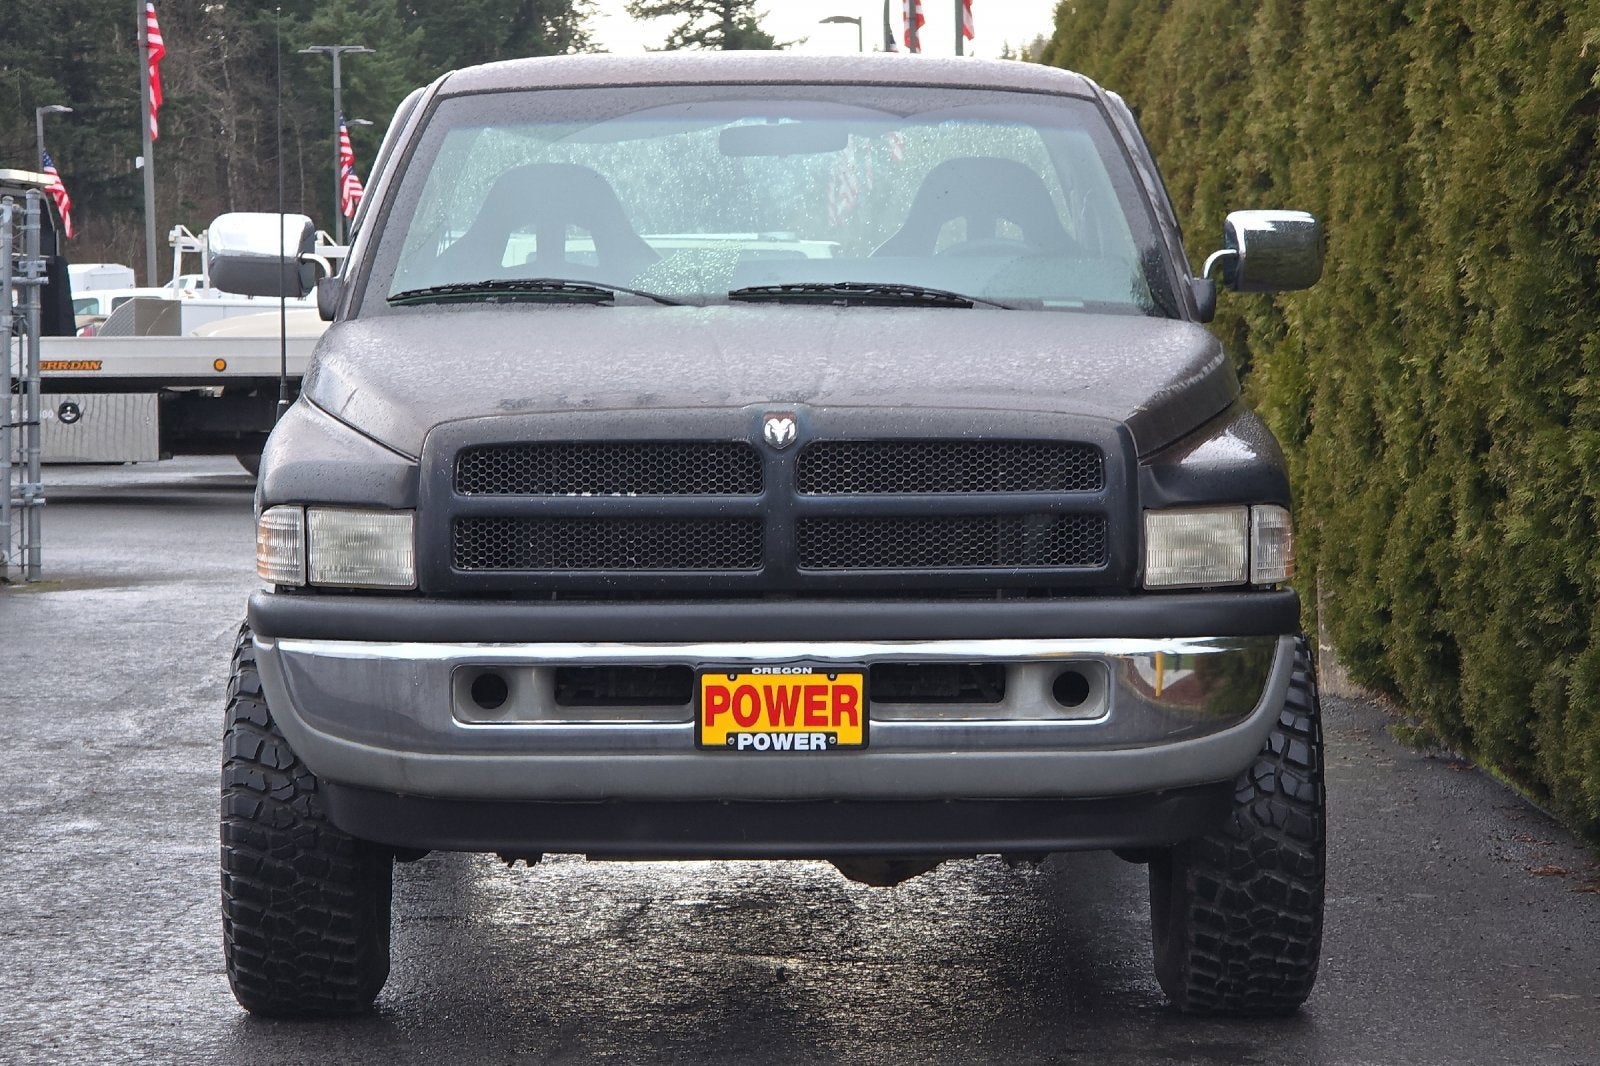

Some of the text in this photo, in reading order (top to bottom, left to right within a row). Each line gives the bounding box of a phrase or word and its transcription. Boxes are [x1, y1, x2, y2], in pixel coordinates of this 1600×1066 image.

[751, 667, 813, 675] OREGON
[705, 684, 859, 728] POWER
[737, 732, 827, 751] POWER
